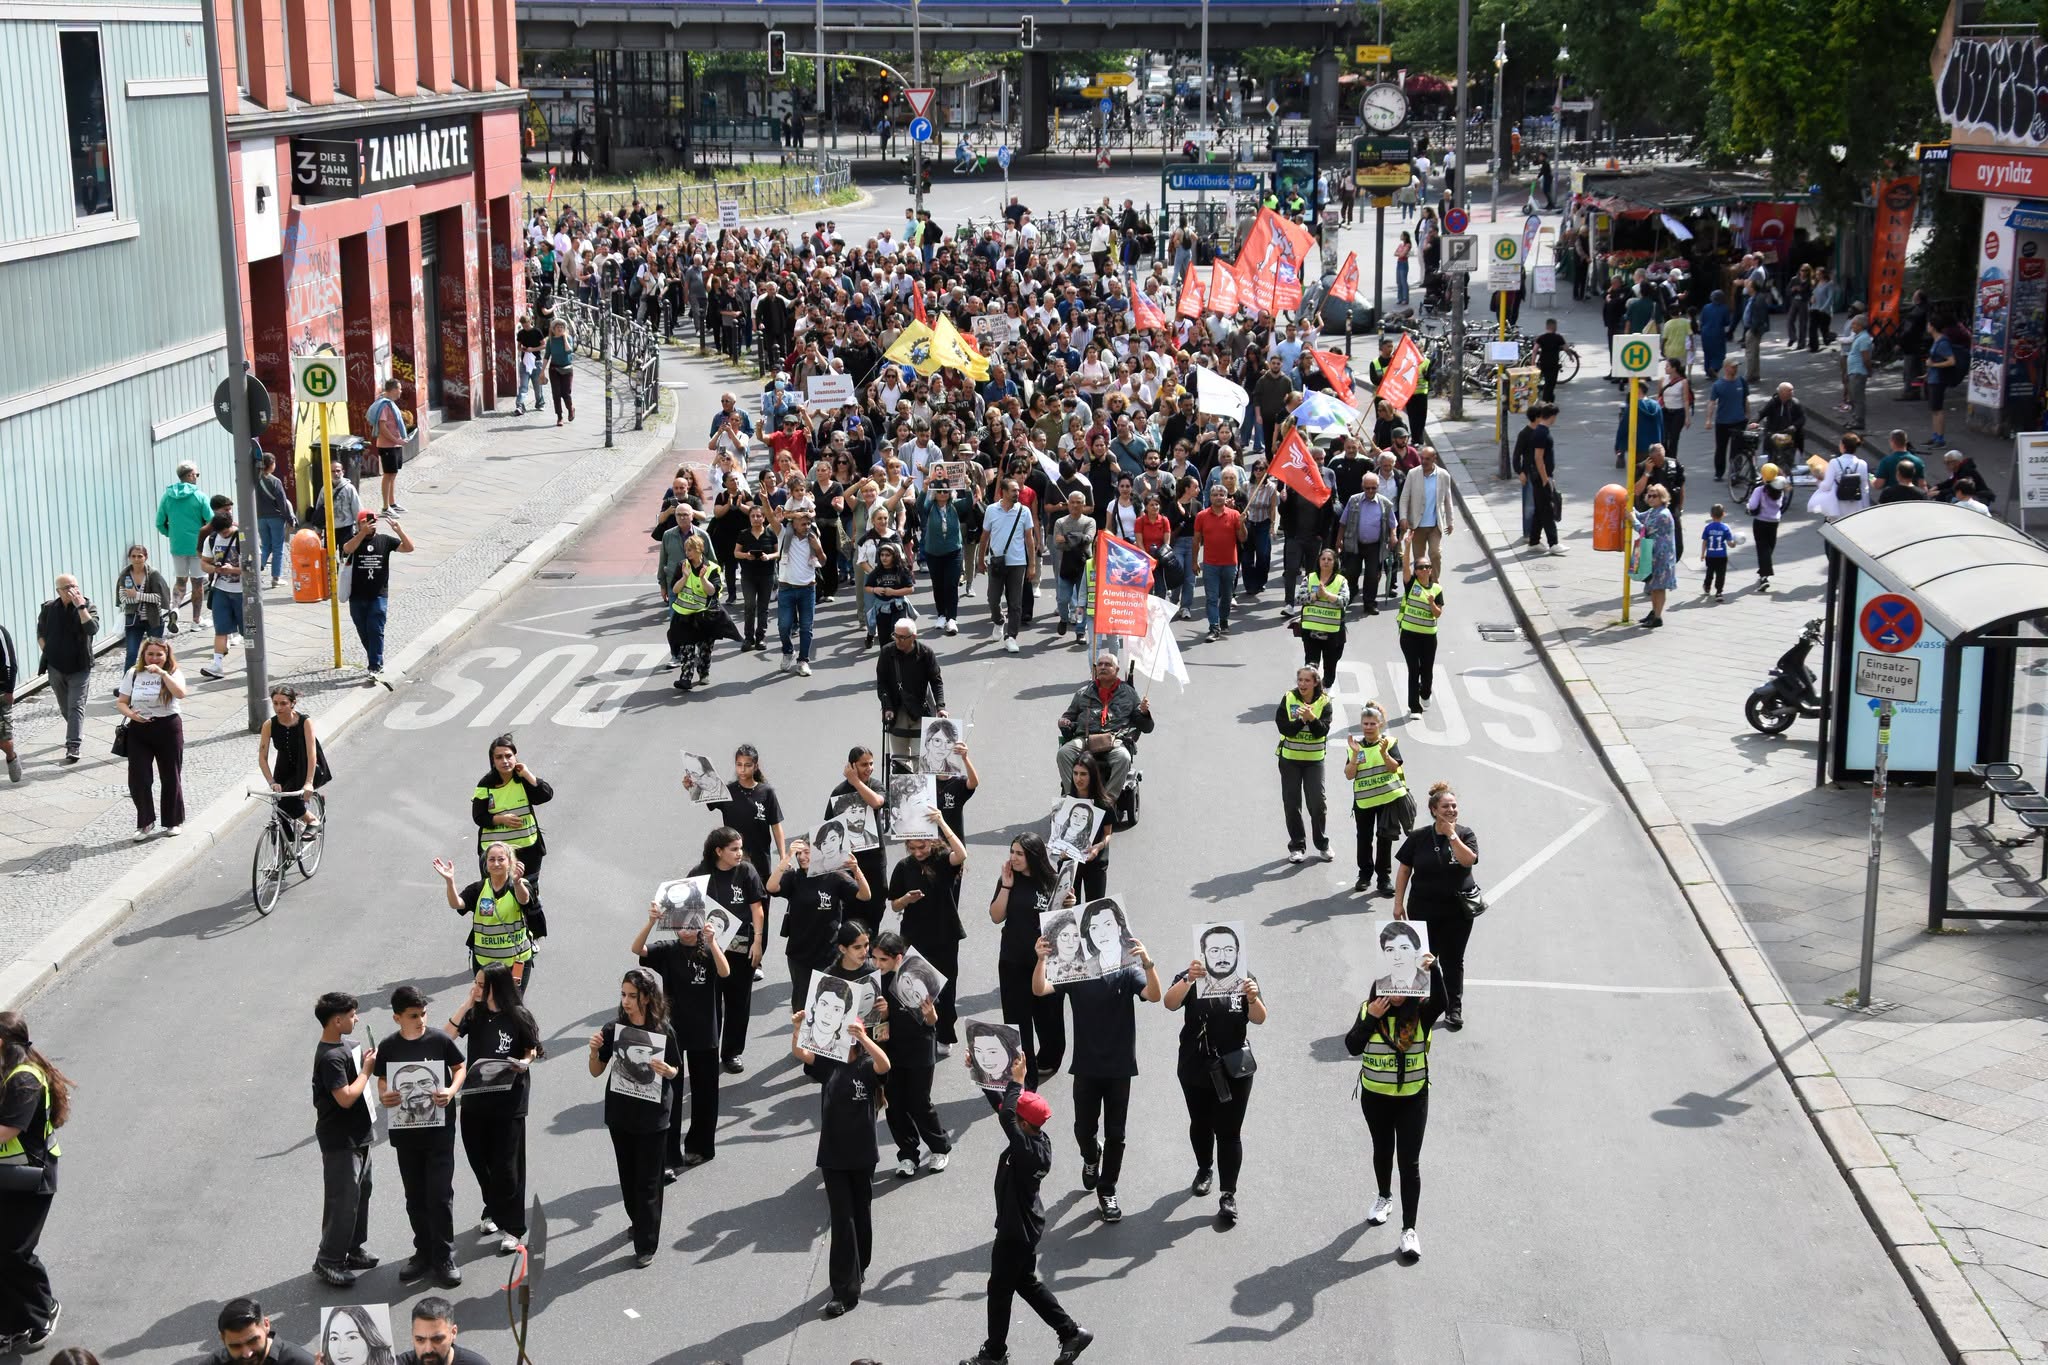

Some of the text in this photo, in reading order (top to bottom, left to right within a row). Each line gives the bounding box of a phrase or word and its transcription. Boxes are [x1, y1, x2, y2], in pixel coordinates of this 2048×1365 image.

[320, 153, 346, 162] DIE 3
[370, 123, 468, 181] ZAHNÄRZTE
[1924, 150, 1948, 159] ATM
[320, 165, 348, 175] ZAHN
[1977, 161, 2032, 187] ay yıldız
[320, 177, 352, 187] ÄRZTE
[1173, 175, 1183, 187] U
[1238, 175, 1252, 186] Tor
[1500, 243, 1512, 256] H
[1879, 214, 1903, 312] KOKORE
[1629, 348, 1645, 365] H
[311, 372, 329, 391] H
[1708, 535, 1724, 551] 11
[1111, 608, 1134, 616] Berlin
[1108, 617, 1136, 625] Cemevi
[1866, 658, 1910, 672] Einsatz-
[1861, 669, 1914, 686] fahrzeuge
[384, 644, 674, 730] BUS
[1877, 683, 1895, 695] frei
[1362, 1055, 1418, 1068] BERLIN-CEEVI
